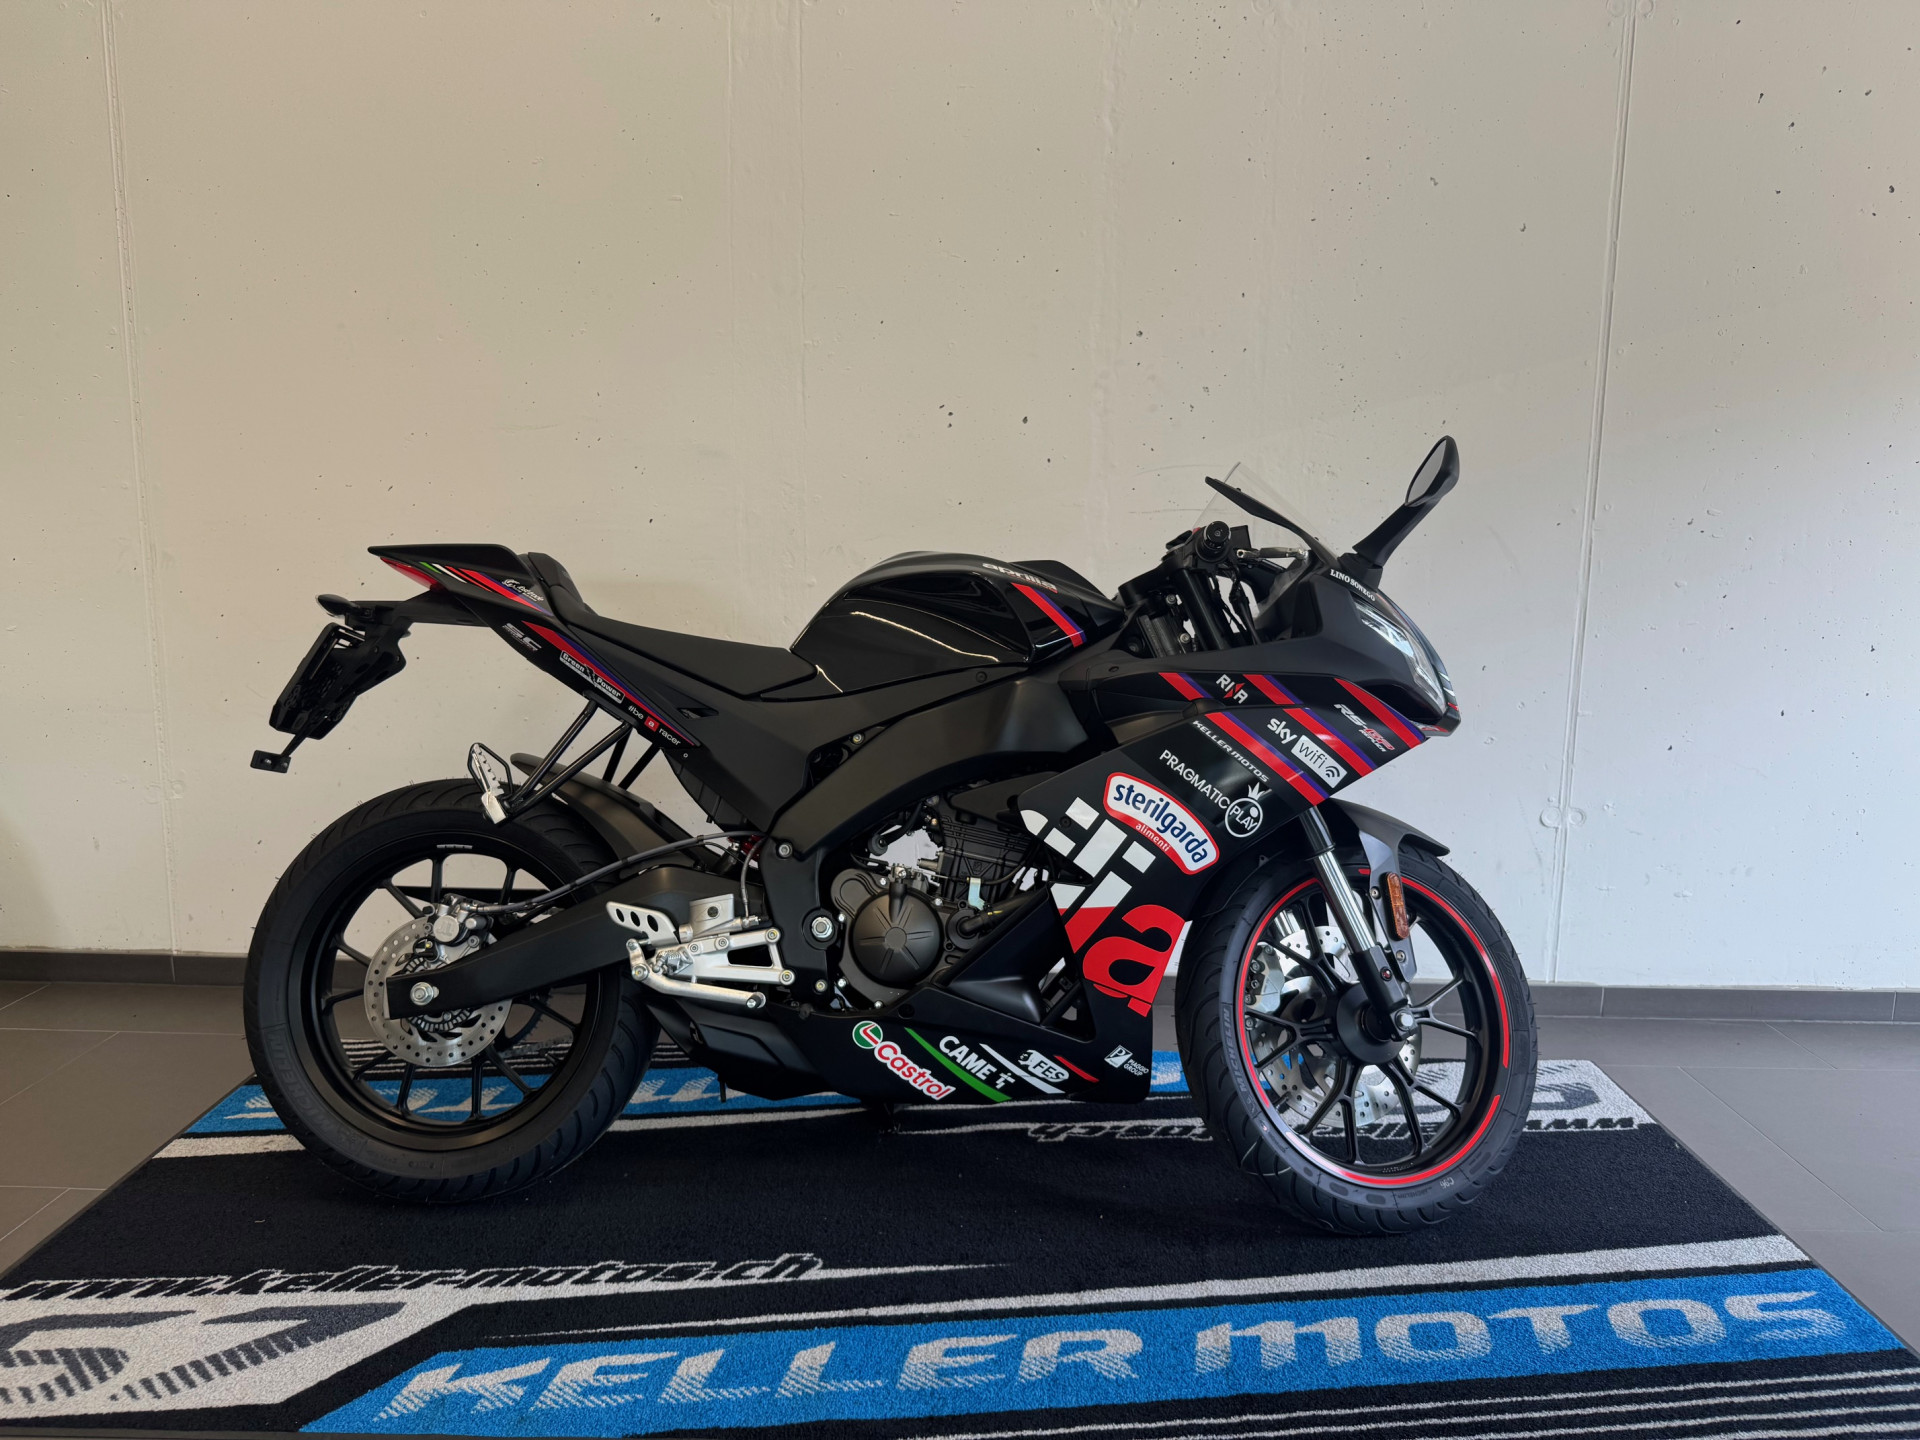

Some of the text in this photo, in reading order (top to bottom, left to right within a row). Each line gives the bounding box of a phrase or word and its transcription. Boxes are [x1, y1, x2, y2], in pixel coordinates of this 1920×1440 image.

[1330, 569, 1376, 601] LINO SONEGO
[563, 653, 621, 698] Green Power
[659, 728, 681, 746] racer
[1193, 720, 1270, 783] KELLER MOTOS
[1267, 718, 1328, 769] sky wifi
[1159, 750, 1258, 831] PRAGMATIC PLAY
[1113, 784, 1208, 863] sterilgarda
[1135, 823, 1171, 852] alimenti
[876, 1043, 951, 1098] Castrol
[939, 1036, 997, 1081] CAME
[1123, 1064, 1143, 1076] GROUP
[1128, 1059, 1150, 1073] PIAGGIO
[1221, 1007, 1248, 1093] MICHELIN
[373, 1291, 1849, 1421] KELLER MOTOS
